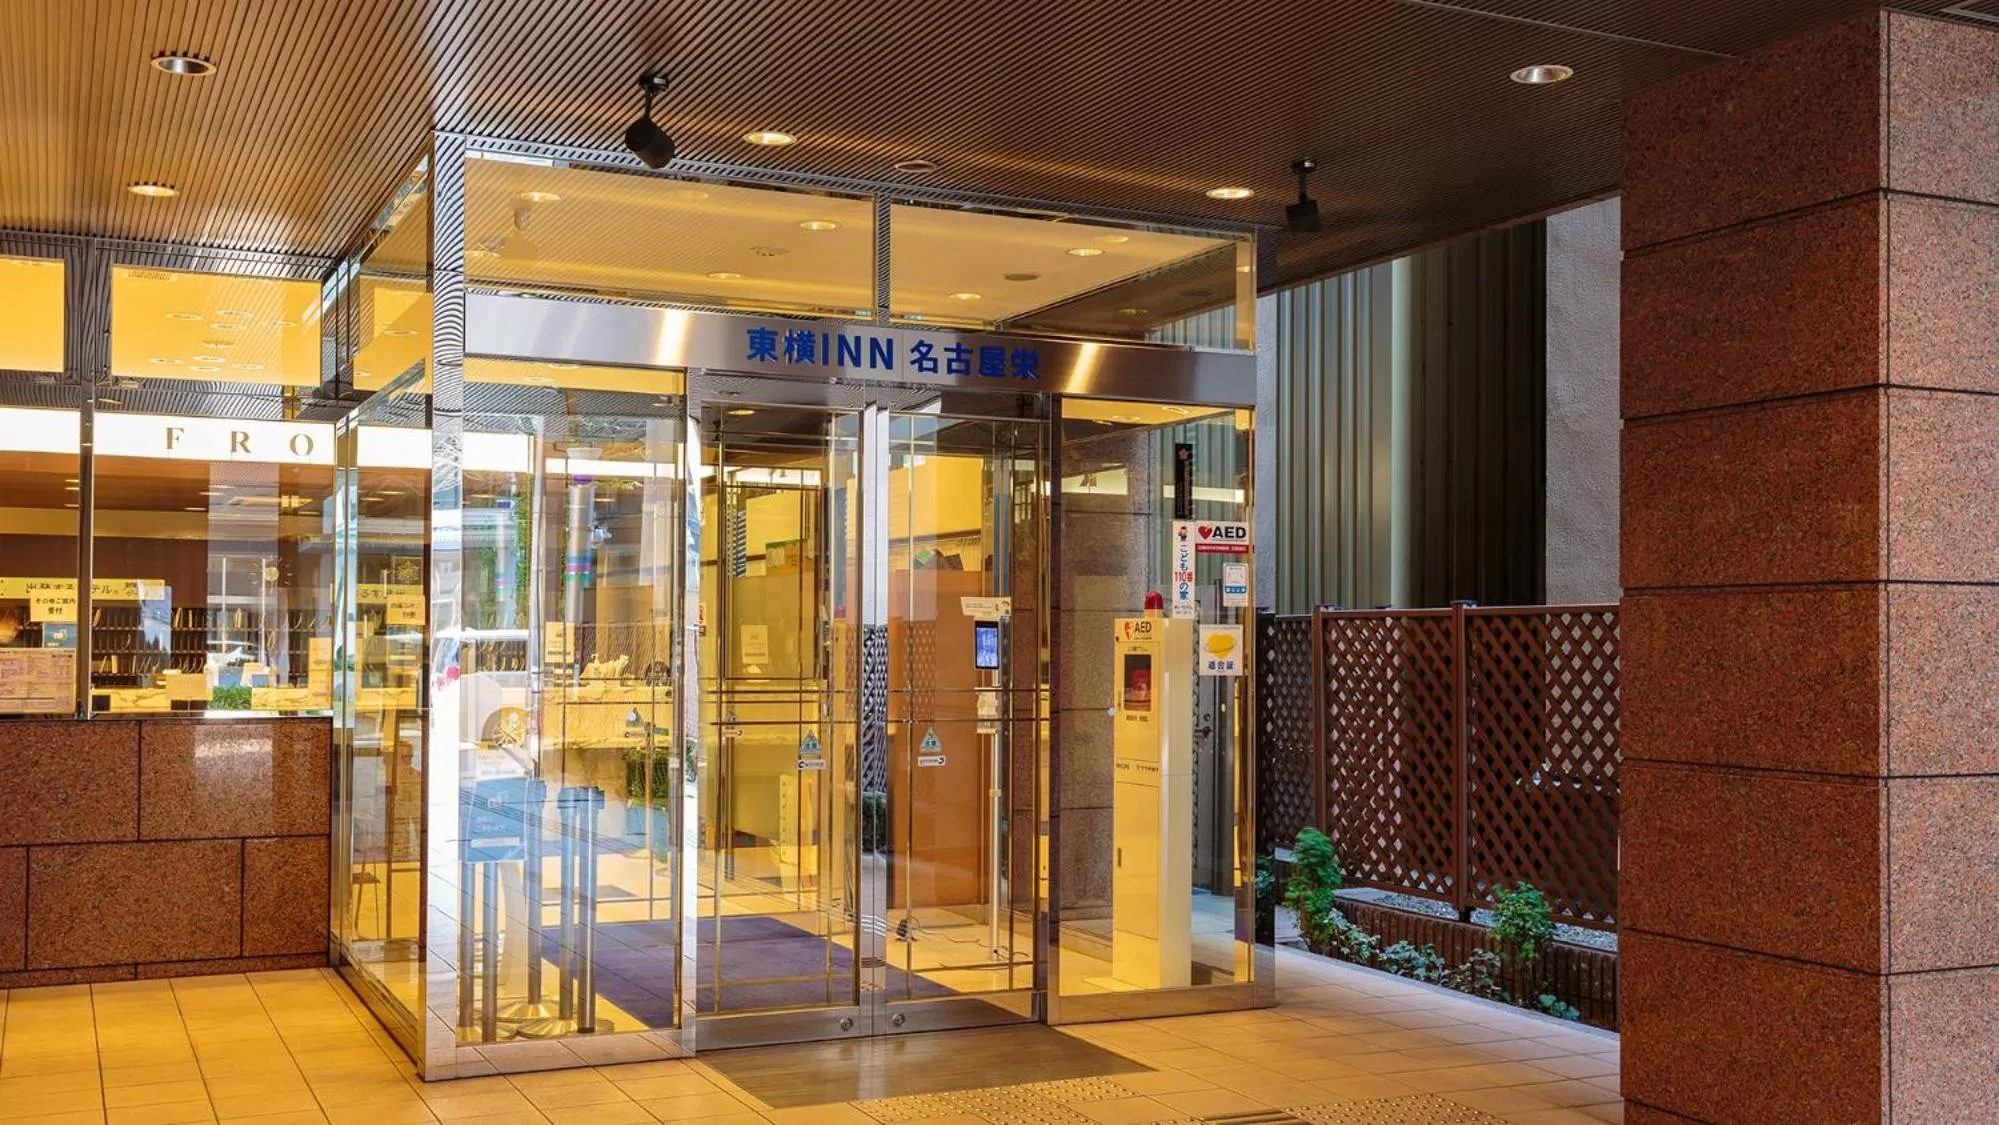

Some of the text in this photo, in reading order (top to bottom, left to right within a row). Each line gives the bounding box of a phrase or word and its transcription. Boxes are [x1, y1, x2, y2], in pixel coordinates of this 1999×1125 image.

[746, 327, 1041, 380] 東横INN 名古屋栄
[1212, 526, 1247, 539] AED
[1134, 620, 1153, 633] AED
